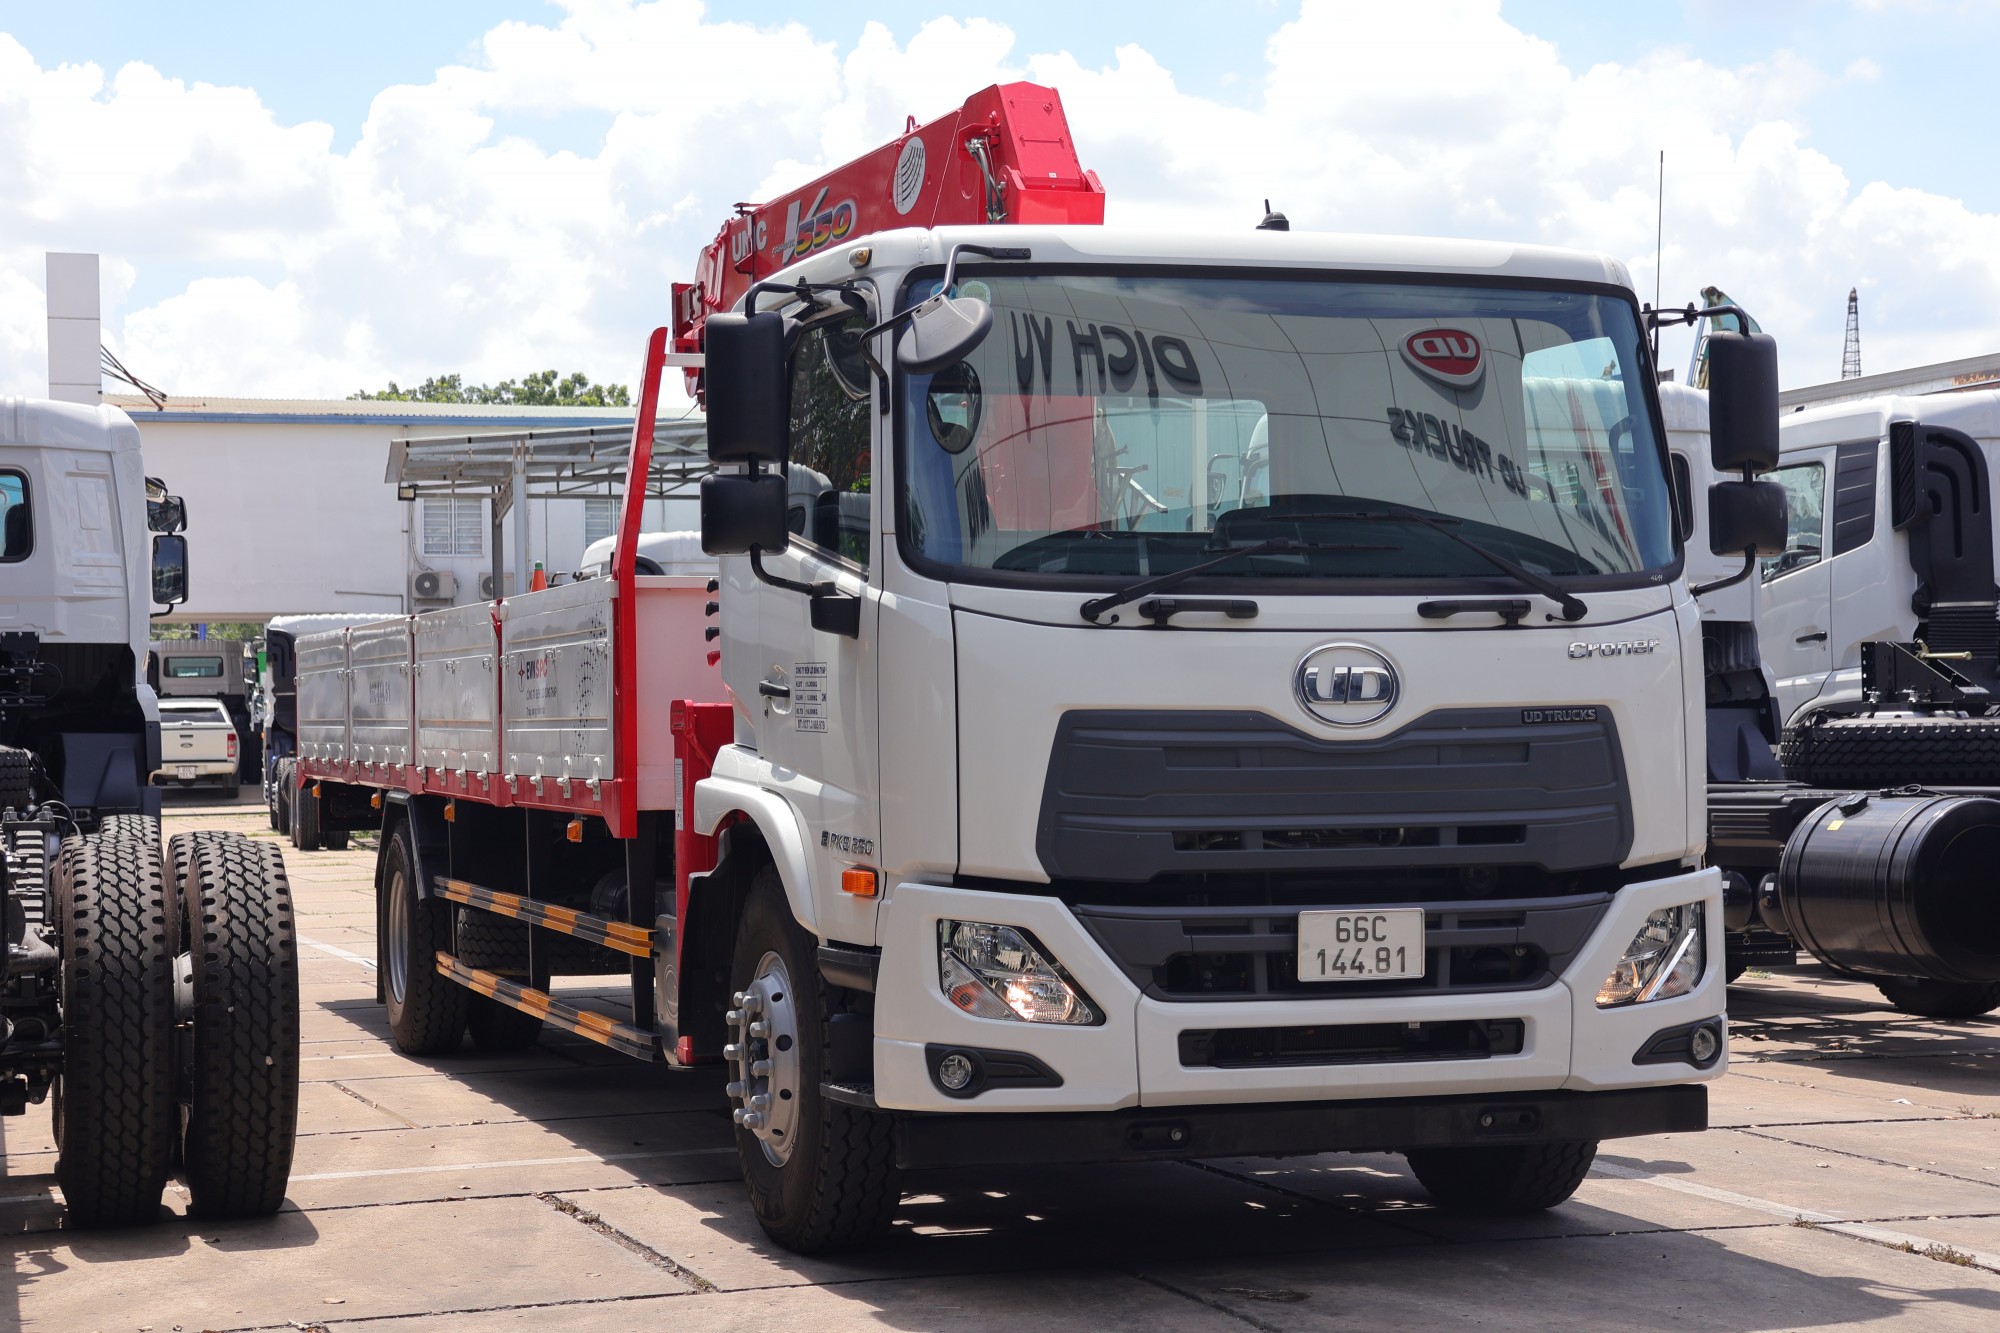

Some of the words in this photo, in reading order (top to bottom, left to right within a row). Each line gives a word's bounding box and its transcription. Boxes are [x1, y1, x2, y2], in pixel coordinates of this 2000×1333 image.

[1567, 639, 1661, 660] Croner
[1304, 666, 1391, 703] UD
[1523, 711, 1543, 723] UD
[1545, 709, 1596, 722] TRUCKS
[1335, 915, 1387, 943] 66C
[1316, 946, 1406, 976] 144.81
